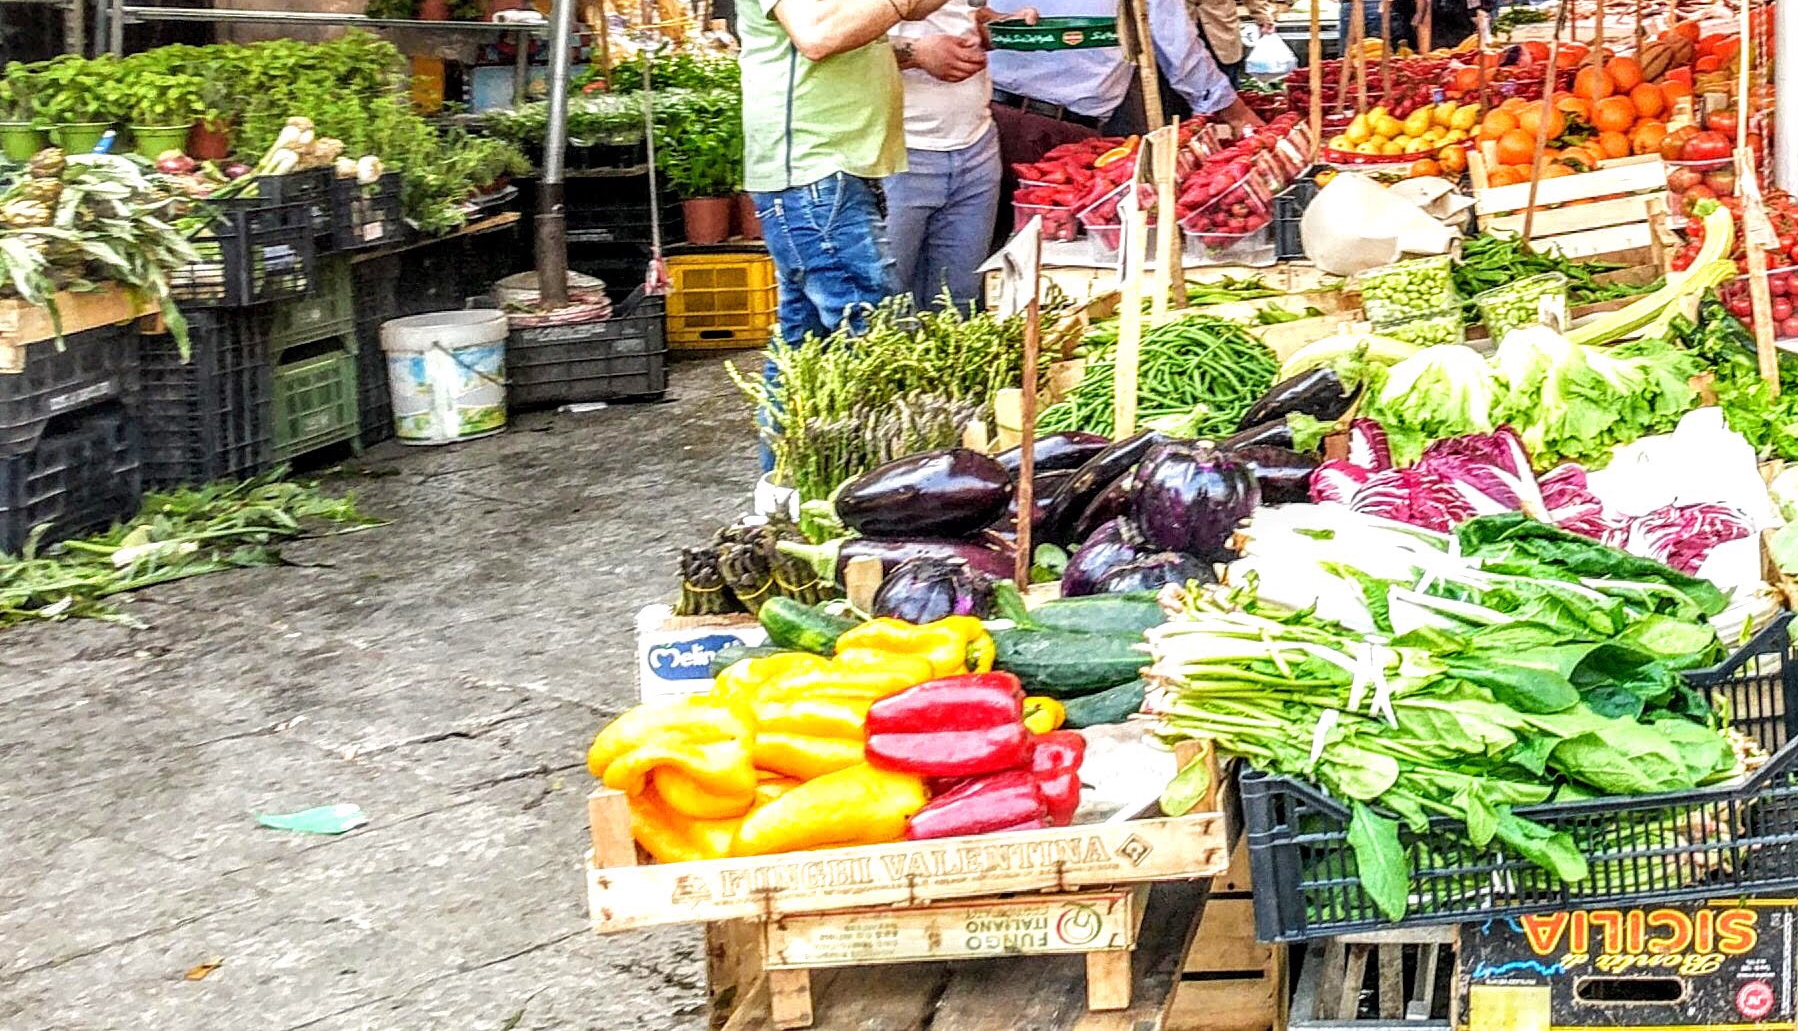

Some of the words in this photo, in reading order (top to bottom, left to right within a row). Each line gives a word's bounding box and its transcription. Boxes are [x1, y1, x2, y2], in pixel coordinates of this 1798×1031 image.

[720, 855, 873, 897] FUNGHI
[881, 835, 1111, 882] VALENTINA
[965, 916, 1050, 934] ITALIANO
[965, 931, 1049, 953] FUNGO
[1519, 908, 1759, 956] SICILIA
